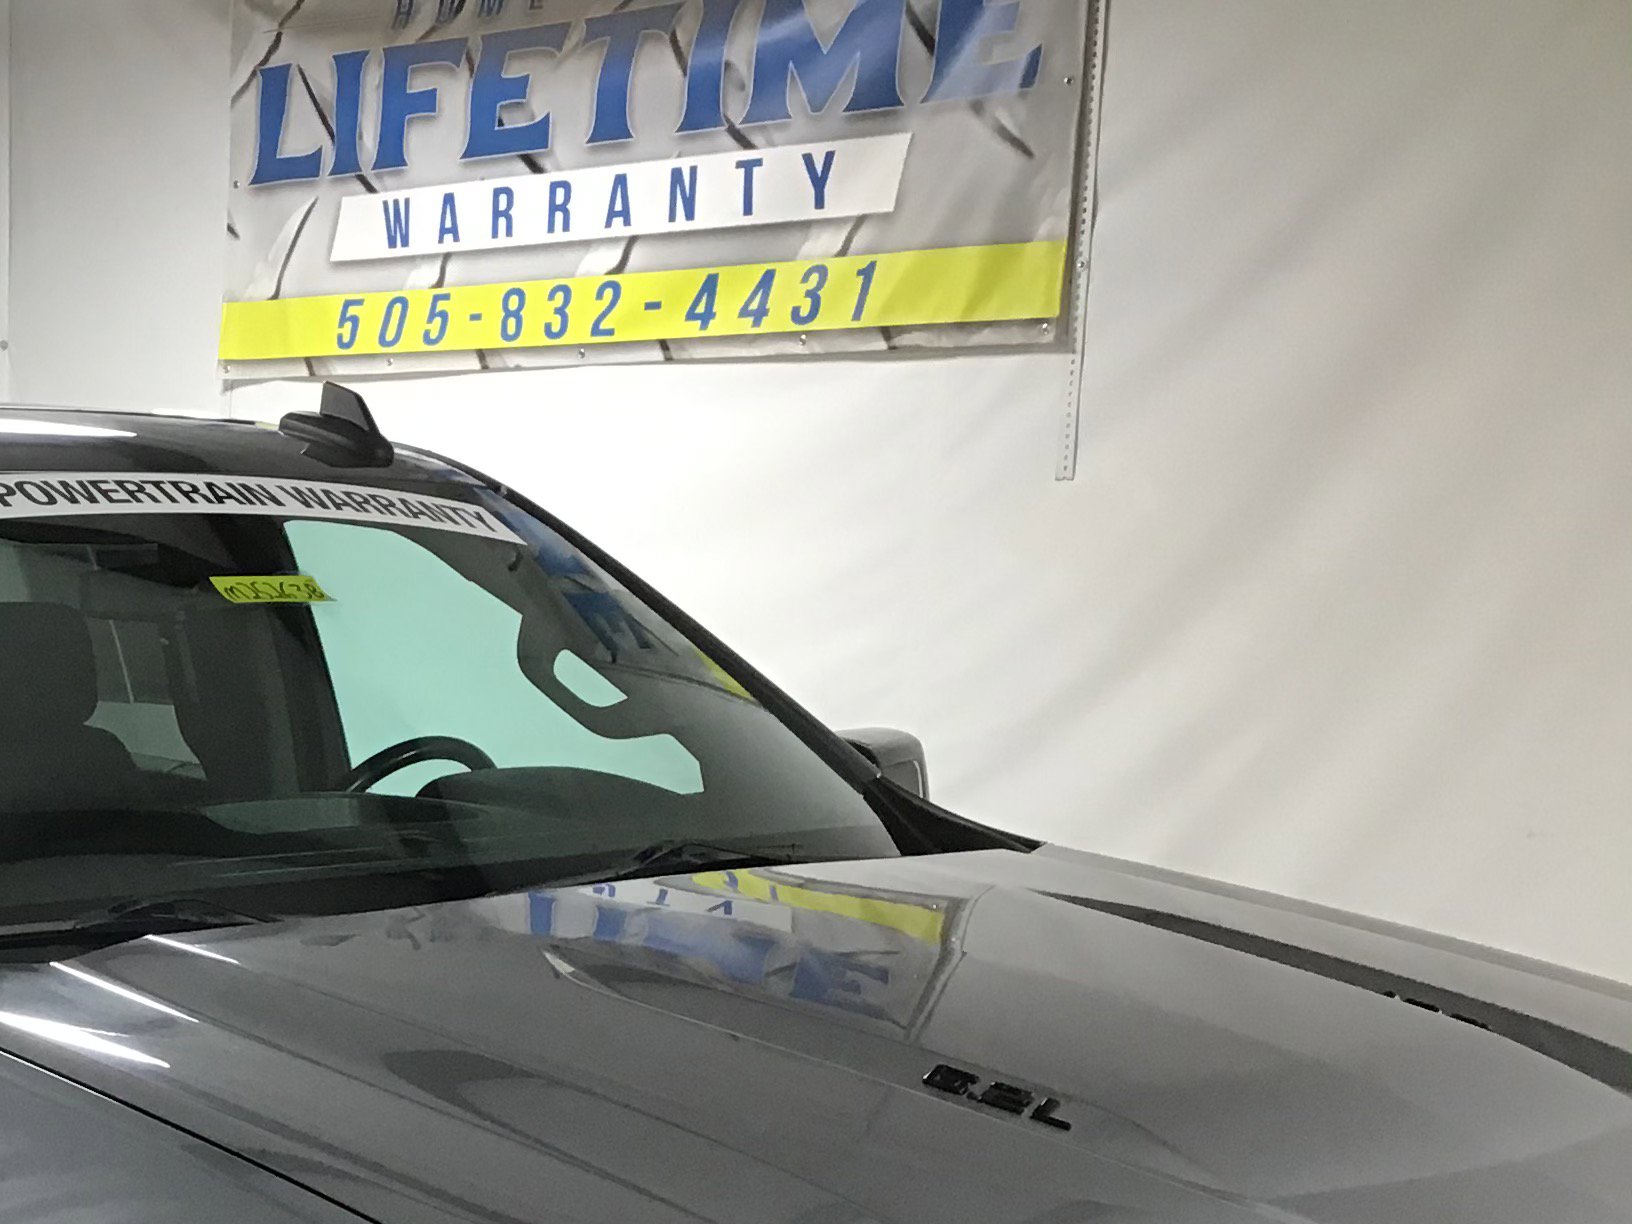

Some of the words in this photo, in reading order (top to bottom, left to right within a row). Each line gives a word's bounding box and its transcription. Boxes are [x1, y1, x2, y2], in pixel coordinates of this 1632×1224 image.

[247, 0, 1042, 187] LIFETIME
[382, 150, 836, 249] WARRANTY
[335, 260, 878, 350] 505-832-4431
[277, 484, 498, 532] WARRANTY
